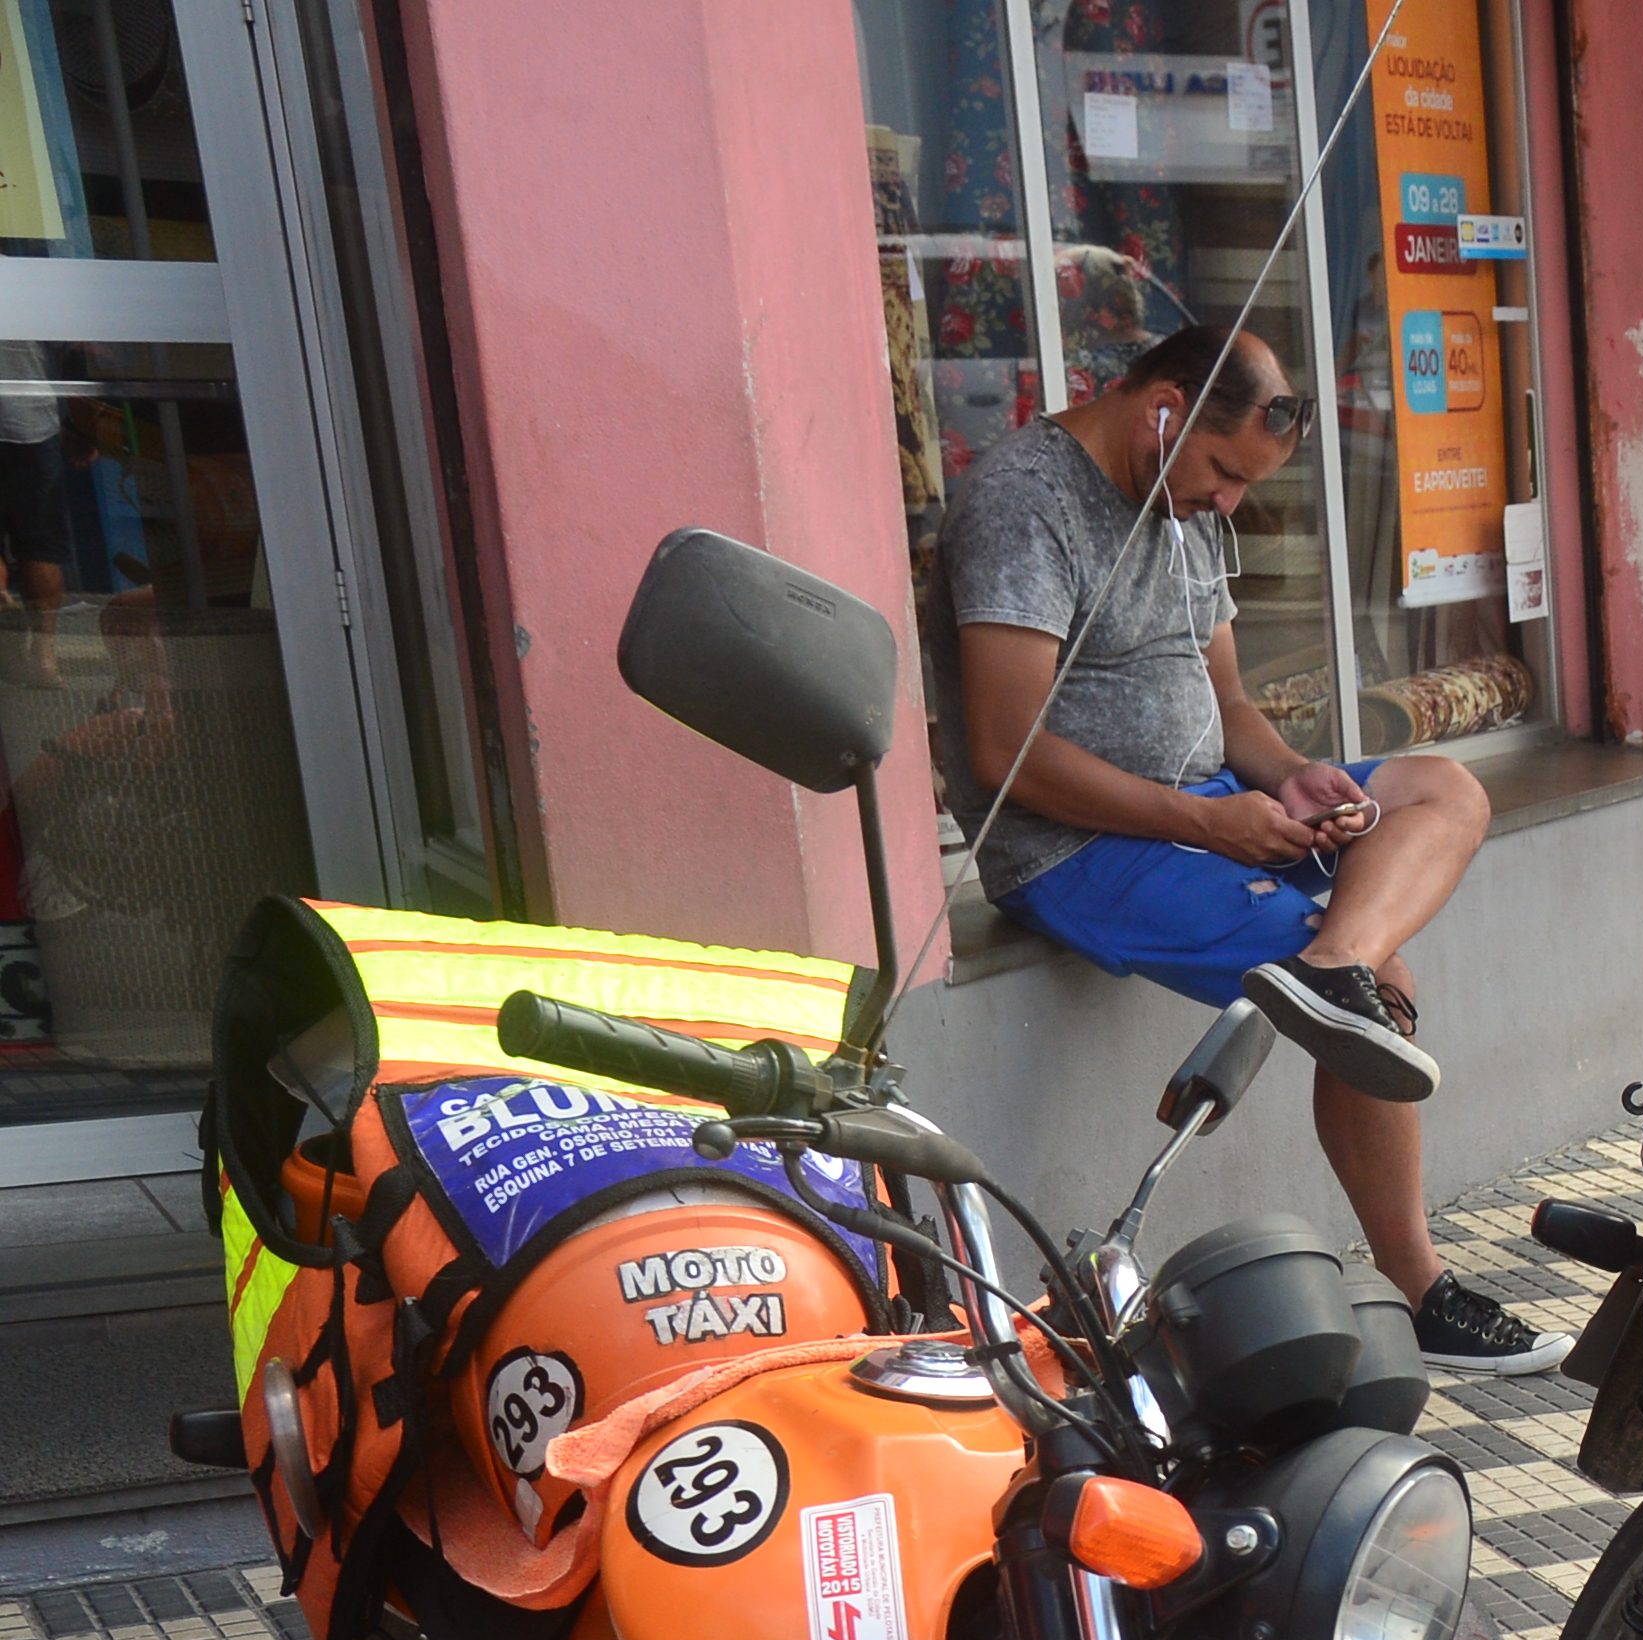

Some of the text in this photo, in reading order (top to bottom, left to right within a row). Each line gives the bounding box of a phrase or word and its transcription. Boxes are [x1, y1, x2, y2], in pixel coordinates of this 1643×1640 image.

[1387, 54, 1456, 88] LIQUIDAÇÃO
[1405, 85, 1453, 111] da cidade
[1385, 110, 1416, 136] ESTÁ
[1418, 117, 1433, 138] DE
[1408, 184, 1430, 212] 09
[1439, 187, 1459, 213] 28
[1404, 235, 1468, 264] JANEIR
[1409, 348, 1439, 376] 400
[619, 1118, 685, 1130] MESA
[474, 1162, 511, 1195] RUA
[512, 1144, 558, 1171] GEN.
[641, 1127, 677, 1137] 701
[483, 1136, 694, 1215] ESQUINA 7 DE SETEMB
[619, 1246, 787, 1303] MOTO
[645, 1291, 787, 1346] TÁXI
[491, 1366, 567, 1470] 293
[654, 1435, 763, 1547] 293
[817, 1520, 839, 1577] MOTOTÁXI
[837, 1516, 858, 1576] VISTORIADO
[821, 1578, 862, 1595] 2015
[874, 1508, 893, 1640] PREFEITURA MUNICIPAL DE PELOTAS
